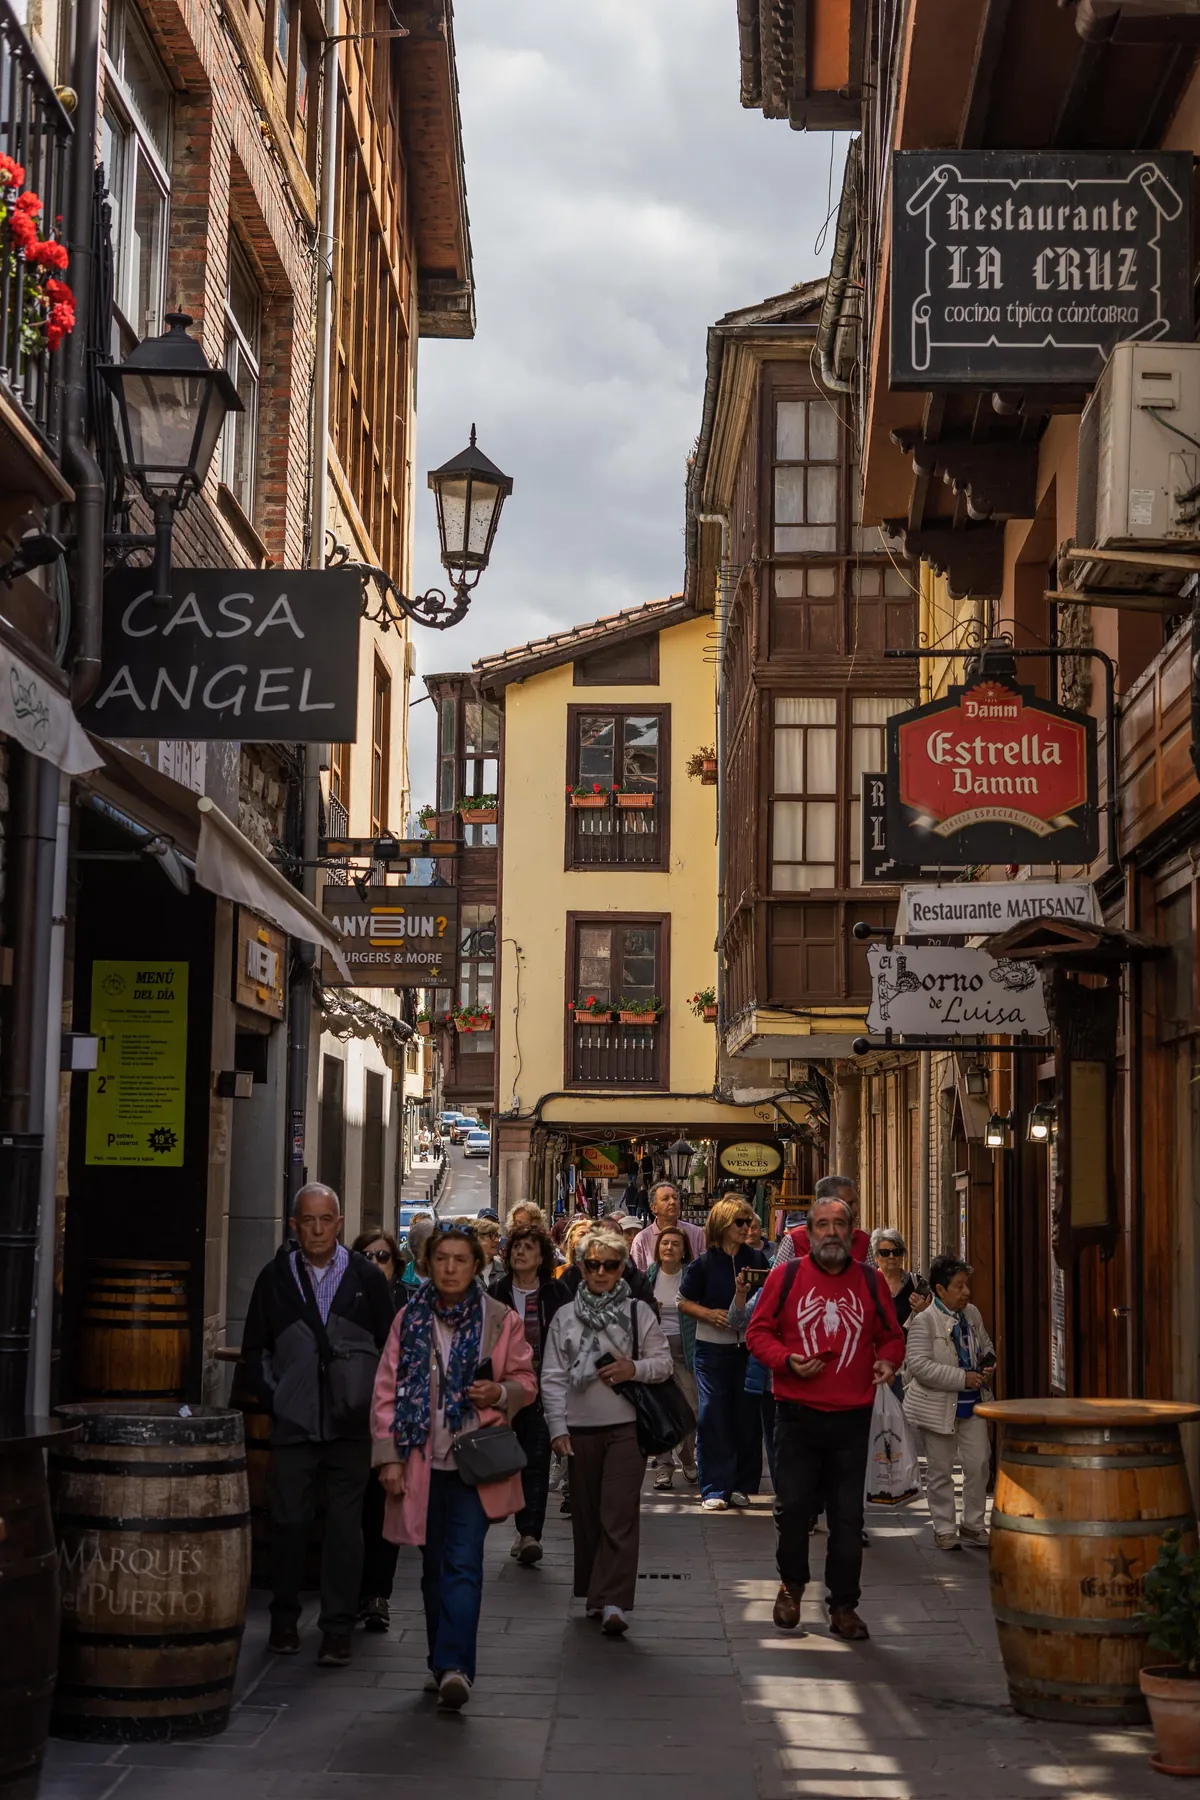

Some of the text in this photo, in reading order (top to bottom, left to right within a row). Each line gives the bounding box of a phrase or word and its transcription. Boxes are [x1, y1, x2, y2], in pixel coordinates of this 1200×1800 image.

[946, 193, 1138, 231] Restaurante
[946, 245, 1138, 291] LA CRUZ
[121, 589, 305, 639] CASA
[95, 664, 335, 716] ANGEL
[965, 701, 1018, 718] Damm
[926, 729, 1062, 766] Estrella
[952, 768, 1039, 795] Damm
[974, 809, 1018, 821] ESPECIAL
[913, 897, 1085, 921] Restaurante MATESANZ
[342, 952, 442, 964] URGERS & MORE
[879, 955, 893, 969] El
[136, 968, 175, 984] MENÚ
[133, 987, 175, 1000] DEL DÍA
[929, 996, 1026, 1025] de Luisa
[58, 1538, 202, 1580] MARQUÉS
[84, 1582, 204, 1616] PUERTO
[1080, 1575, 1140, 1598] Estrel
